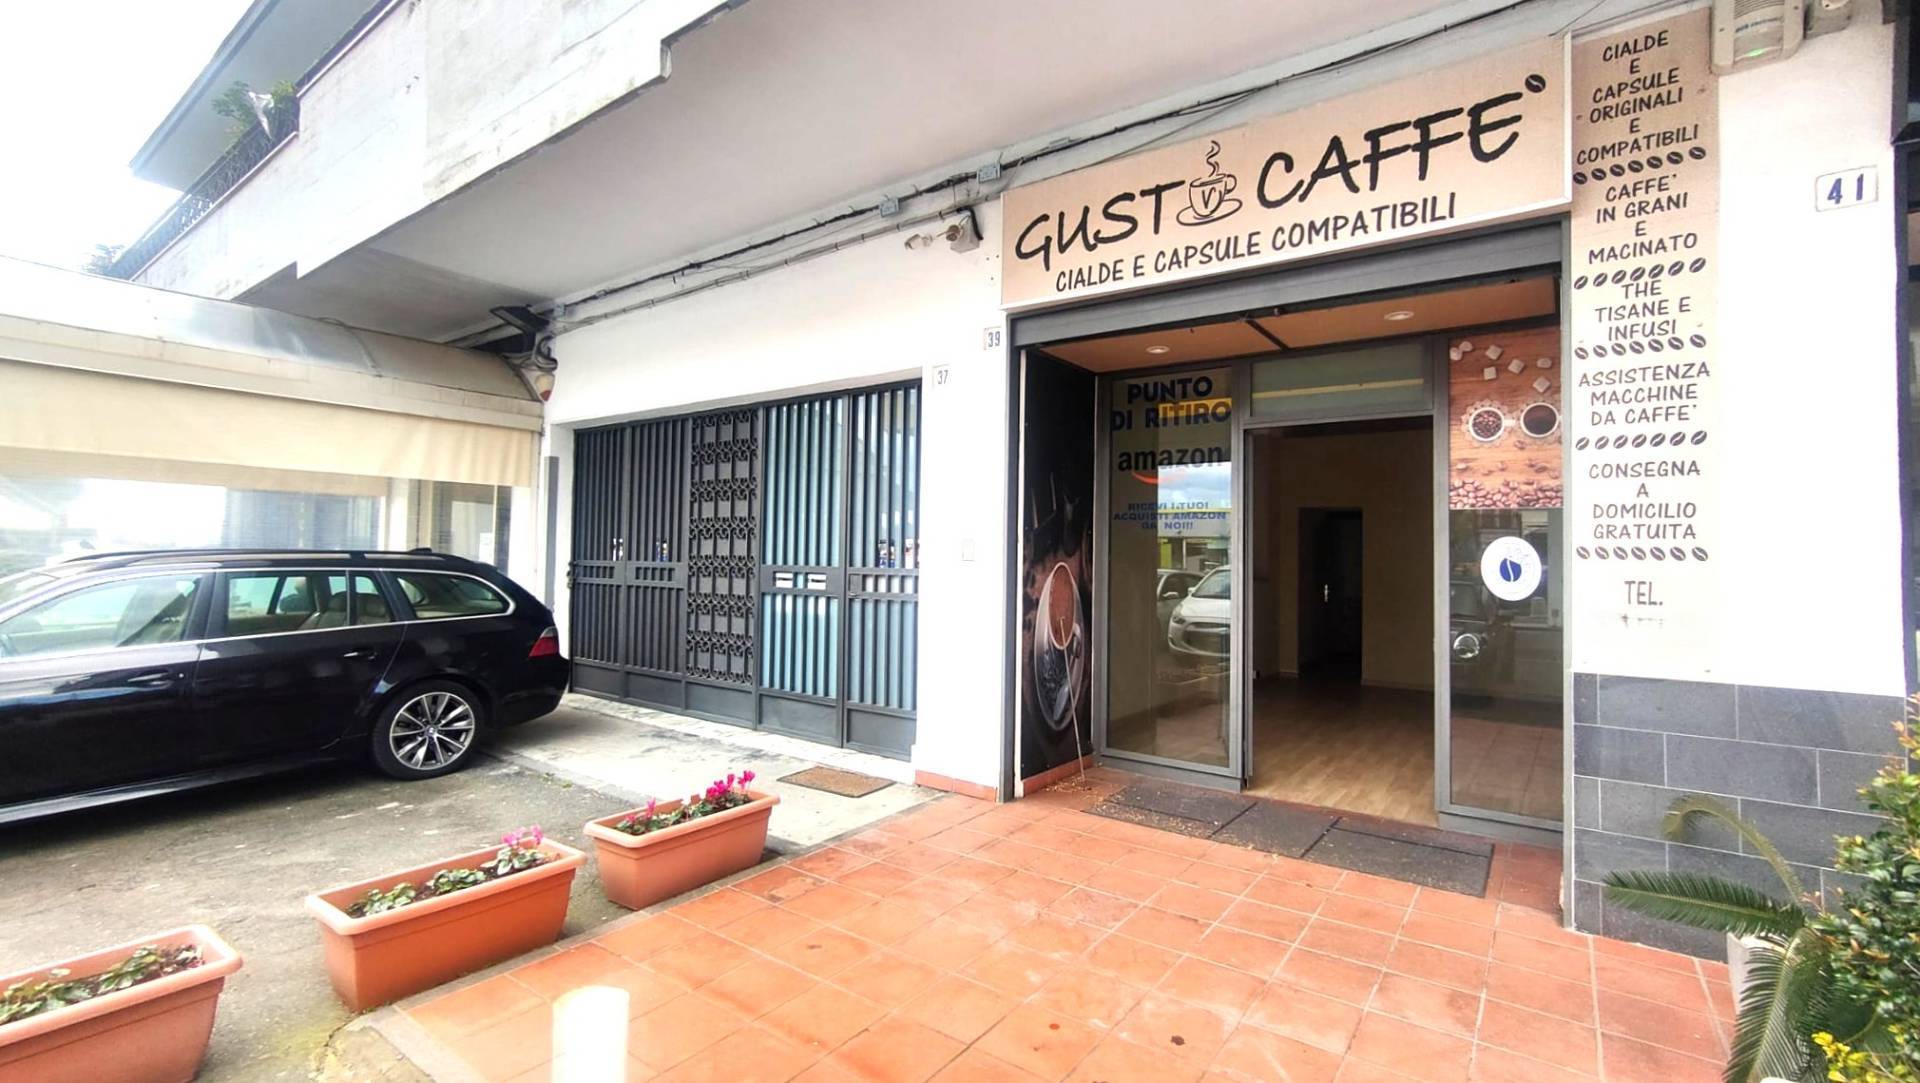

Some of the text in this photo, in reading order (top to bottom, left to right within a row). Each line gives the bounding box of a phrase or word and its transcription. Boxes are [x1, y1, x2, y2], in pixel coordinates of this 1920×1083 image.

[1603, 30, 1669, 62] CIALDE
[1630, 58, 1640, 74] E
[1593, 68, 1680, 103] CAPSULE
[1590, 88, 1683, 123] ORIGINALI
[1630, 118, 1641, 134] E
[1577, 124, 1698, 165] COMPATIBILI
[1827, 174, 1864, 205] 41
[1596, 192, 1688, 224] IN GRANI
[1635, 220, 1647, 236] E
[1056, 192, 1456, 292] CIALDE E CAPSULE COMPATIBILI
[1588, 232, 1698, 264] MACINATO
[1622, 280, 1662, 299] THE
[1595, 296, 1691, 322] TISANE E
[988, 330, 1000, 348] 39
[1608, 320, 1676, 341] INFUSI
[937, 370, 948, 385] 37
[1578, 362, 1710, 387] ASSISTENZA
[1127, 376, 1213, 404] PUNTO
[1590, 384, 1698, 406] MACCHINE
[1111, 401, 1232, 431] DI RITIRO
[1591, 404, 1697, 426] DA CAFFE'
[1118, 446, 1223, 472] amazon
[1589, 460, 1700, 478] CONSEGNA
[1636, 483, 1649, 498] A
[1172, 512, 1226, 520] AMAZON
[1593, 502, 1697, 519] DOMICILIO
[1594, 524, 1696, 540] GRATUITA
[1624, 580, 1663, 606] TEL.
